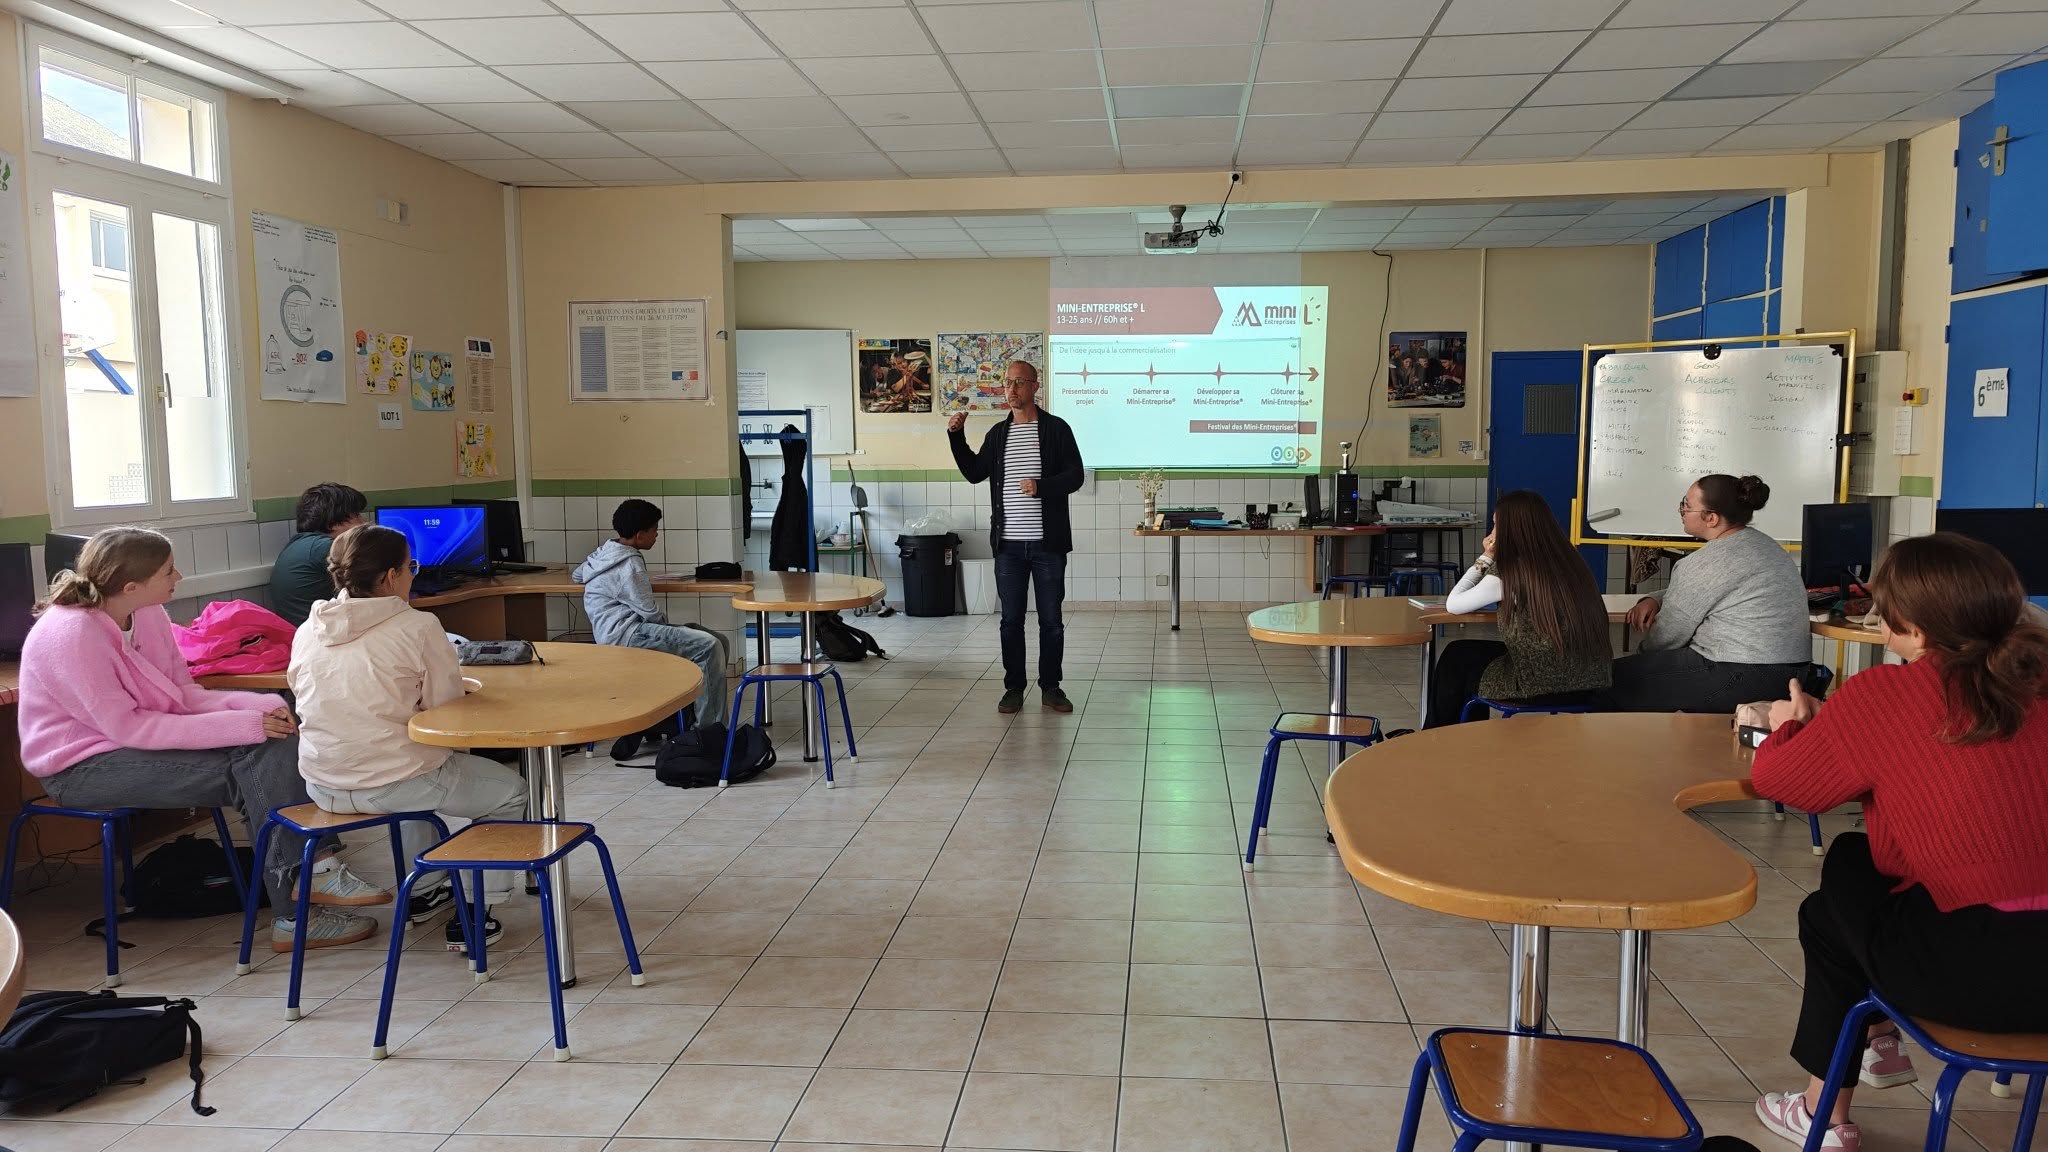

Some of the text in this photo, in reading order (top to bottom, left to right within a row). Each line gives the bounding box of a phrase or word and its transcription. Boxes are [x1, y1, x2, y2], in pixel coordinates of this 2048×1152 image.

[1140, 303, 1146, 313] L
[1056, 315, 1078, 324] 13-25
[1103, 315, 1118, 324] 60h
[1119, 316, 1128, 324] et
[1059, 346, 1069, 354] De
[1111, 346, 1117, 354] la
[1118, 346, 1176, 354] commercialisation
[1062, 387, 1109, 395] Présentation du
[1132, 387, 1160, 395] Démarrer
[1196, 388, 1232, 396] Développer
[1978, 376, 2005, 407] 6ème
[1075, 398, 1095, 406] projet
[395, 411, 400, 421] 1
[1207, 423, 1231, 431] Festival
[1231, 423, 1243, 431] des
[423, 518, 441, 526] 11:59
[1877, 1041, 1895, 1050] NIKE
[1843, 1131, 1858, 1139] NIKE
